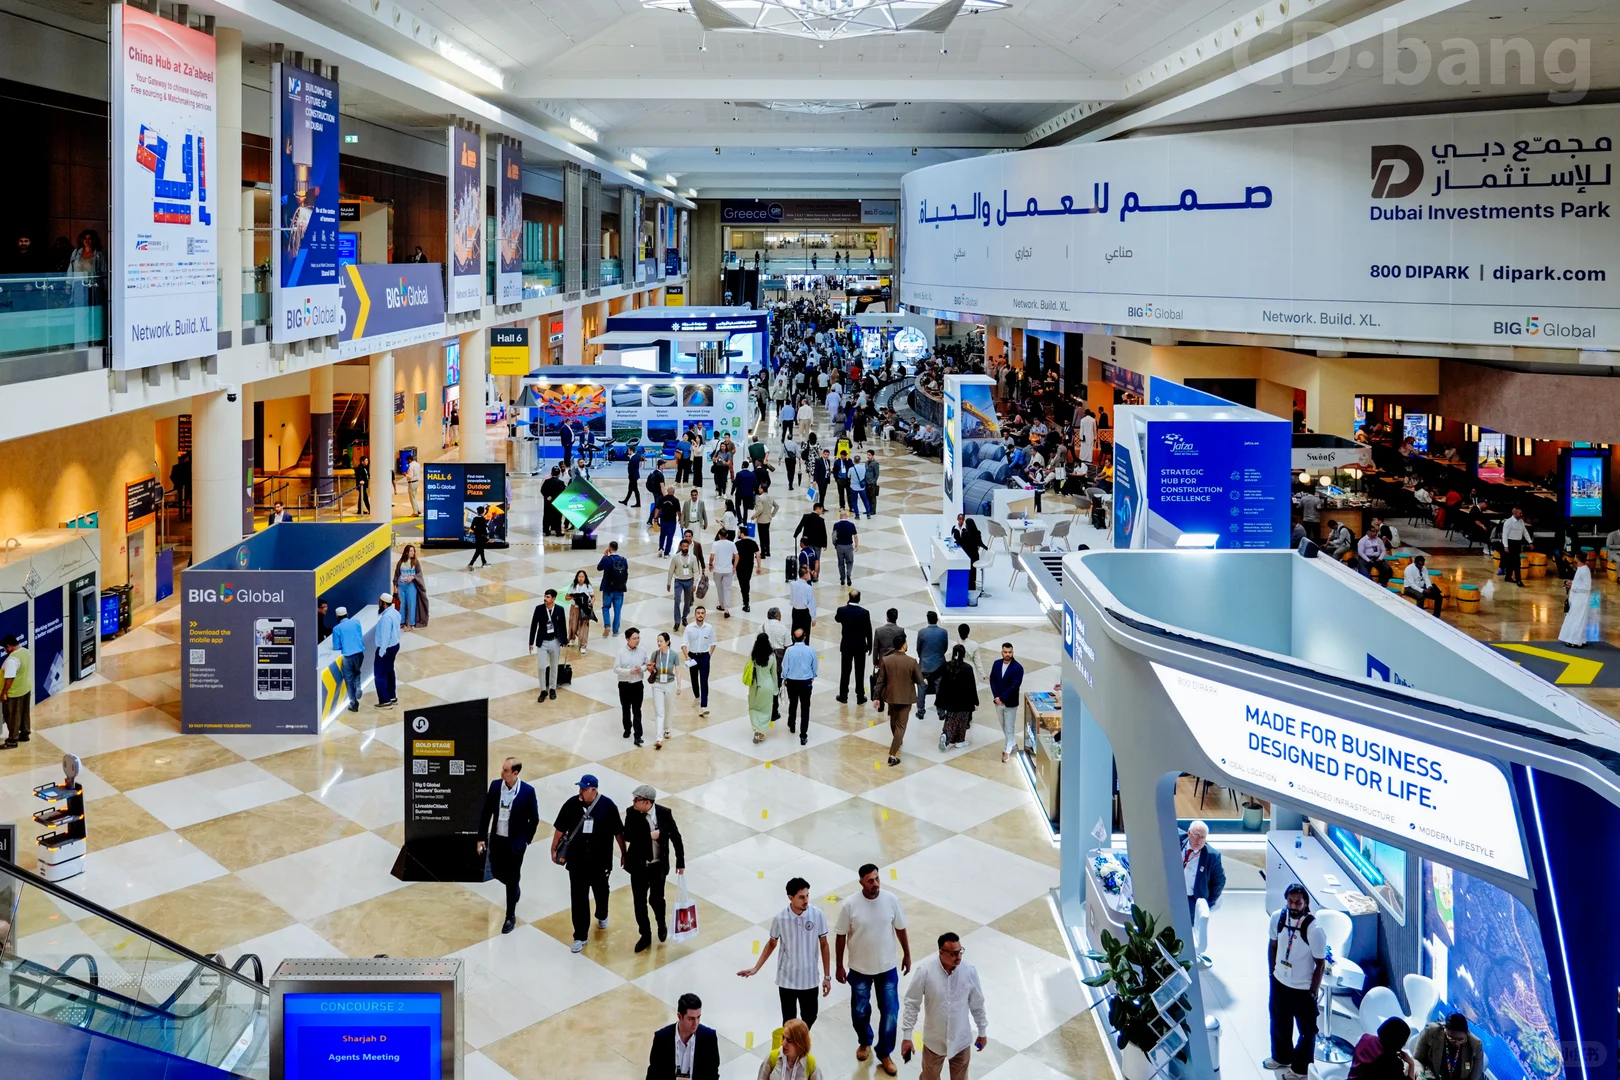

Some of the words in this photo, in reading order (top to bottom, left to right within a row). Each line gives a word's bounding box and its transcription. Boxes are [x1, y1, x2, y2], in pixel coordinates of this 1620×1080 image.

[129, 46, 152, 65] China
[156, 54, 171, 70] Hub
[174, 62, 181, 73] at
[184, 63, 213, 83] Za'abeel
[136, 73, 147, 83] Your
[148, 76, 167, 90] Gateway
[173, 84, 189, 94] chinese
[190, 89, 208, 99] suppliers
[306, 83, 324, 96] BUILDING
[131, 84, 141, 94] Free
[143, 88, 162, 101] sourcing
[168, 94, 195, 109] Matchmaking
[196, 102, 212, 111] services
[305, 95, 321, 107] FUTURE
[321, 100, 327, 108] OF
[305, 108, 335, 123] CONSTRUCTION
[305, 120, 310, 128] IN
[311, 121, 323, 132] DUBAI
[1432, 141, 1505, 164] دبي
[724, 207, 767, 218] Greece
[996, 182, 1108, 226] للعمل
[1120, 184, 1273, 222] صمم
[1370, 206, 1422, 220] Dubai
[1428, 202, 1554, 220] Investments
[1560, 201, 1611, 218] Park
[1105, 245, 1133, 263] صناعي
[1370, 265, 1401, 279] 800
[1406, 265, 1470, 280] DIPARK
[1493, 265, 1606, 283] dipark.com
[386, 287, 400, 309] BIG
[400, 277, 407, 306] 5
[408, 285, 428, 306] Global
[966, 297, 978, 307] Global
[287, 310, 302, 330] BIG
[304, 298, 311, 327] 5
[312, 305, 336, 325] Global
[1013, 299, 1039, 308] Network.
[1040, 301, 1058, 310] Build.
[1060, 302, 1071, 311] XL.
[1128, 306, 1143, 318] BIG
[1145, 303, 1153, 318] 5
[1154, 308, 1183, 320] Global
[1262, 310, 1316, 324] Network.
[1320, 313, 1355, 326] Build.
[1360, 314, 1381, 327] XL.
[1494, 321, 1522, 336] BIG
[1525, 317, 1540, 336] 5
[1543, 323, 1595, 338] Global
[132, 324, 174, 342] Network.
[175, 319, 198, 336] Build.
[200, 317, 213, 332] XL.
[498, 334, 514, 342] Hall
[516, 334, 522, 342] 6
[326, 555, 354, 582] INFORMATION
[355, 548, 365, 562] HELP
[365, 540, 376, 555] DESK
[189, 590, 216, 603] BIG
[220, 584, 233, 603] 5
[237, 590, 284, 603] Global
[35, 623, 47, 633] Working
[48, 618, 59, 628] towards
[47, 623, 62, 634] experience
[1177, 676, 1190, 688] 800
[1193, 680, 1218, 695] DIPARK
[1246, 705, 1295, 736] MADE
[1301, 721, 1336, 749] FOR
[1342, 735, 1448, 784] BUSINESS.
[1228, 760, 1244, 772] IDEAL
[1246, 766, 1277, 783] LOCATION
[1248, 732, 1339, 776] DESIGNED
[1344, 764, 1382, 791] FOR
[1387, 776, 1437, 810] LIFE.
[1297, 784, 1332, 802] ADVANCED
[1334, 796, 1395, 823] INFRASTRUCTURE
[1419, 825, 1451, 843] MODERN
[1453, 836, 1495, 859] LIFESTYLE
[320, 1002, 394, 1011] CONCOURSE
[398, 1002, 405, 1011] 2
[342, 1035, 377, 1043] Sharjah
[328, 1054, 360, 1062] Agents
[362, 1054, 400, 1062] Meeting
